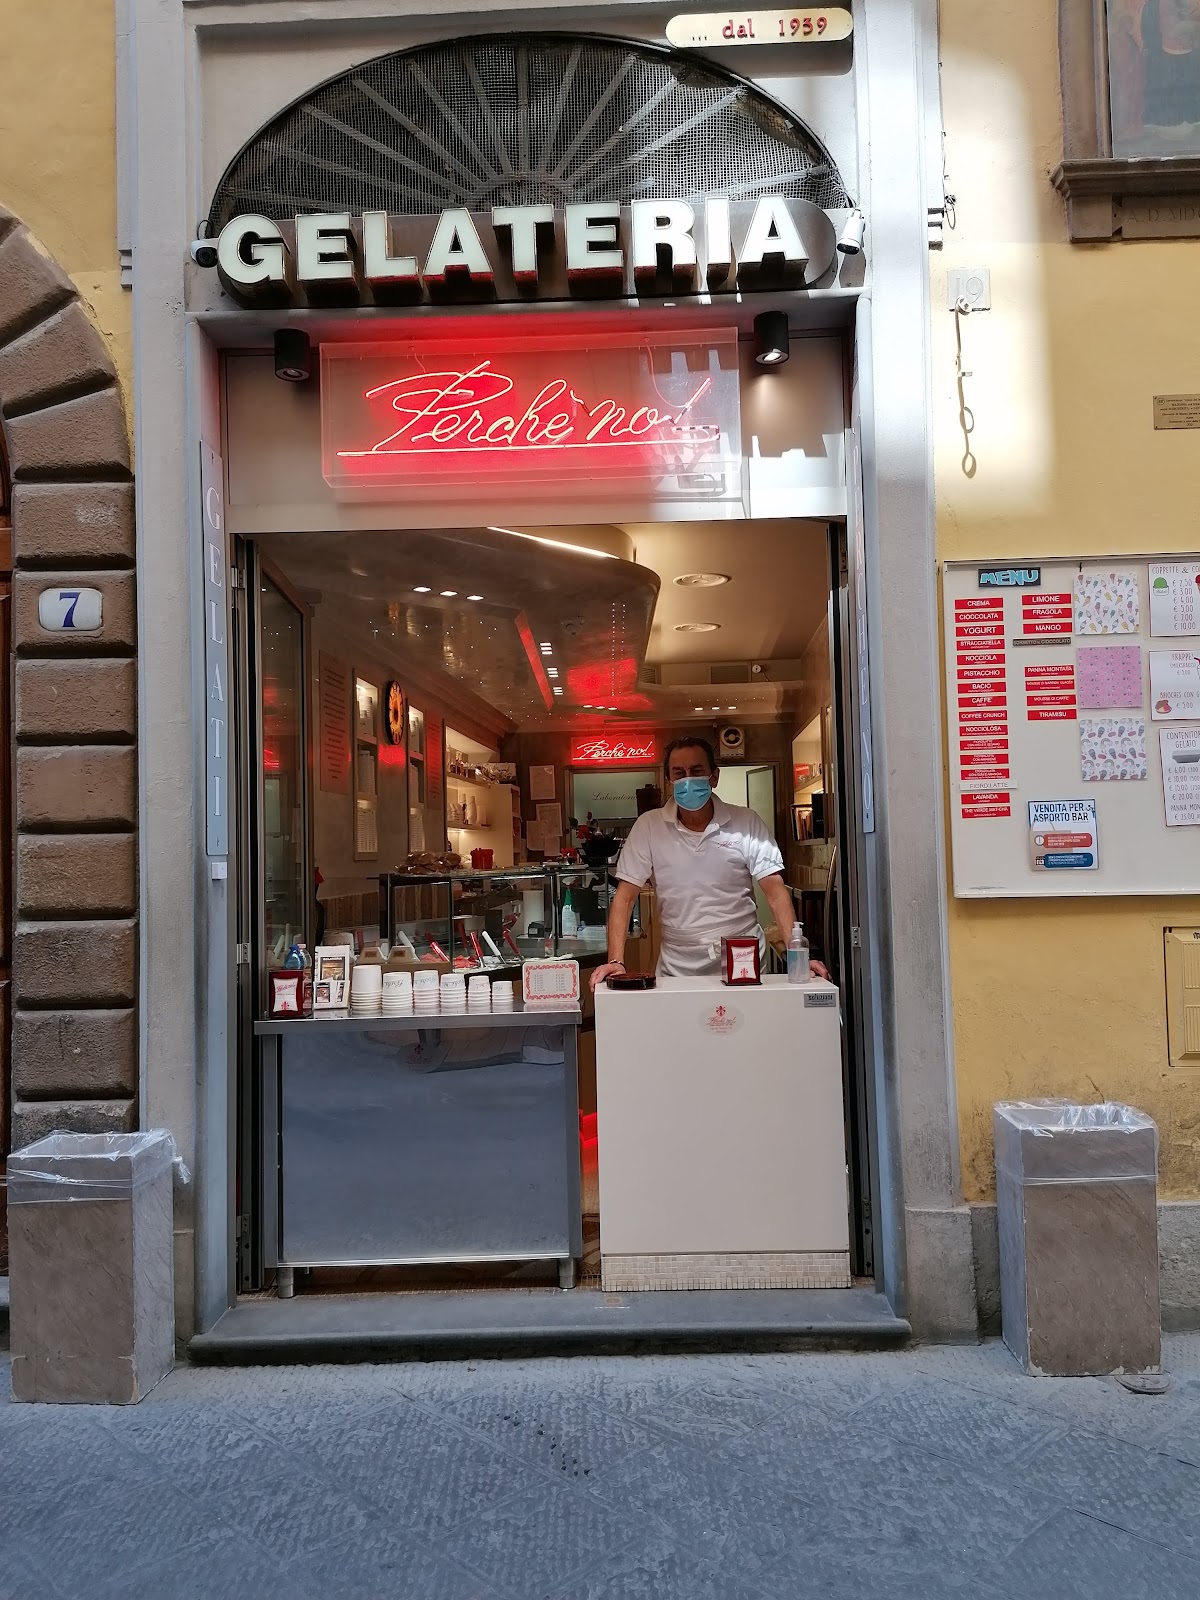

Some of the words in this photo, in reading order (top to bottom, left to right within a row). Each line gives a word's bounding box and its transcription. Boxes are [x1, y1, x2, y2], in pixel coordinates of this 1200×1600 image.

[722, 18, 755, 39] dal
[778, 16, 828, 37] 1939
[216, 194, 809, 284] GELATERIA
[980, 570, 1039, 586] MENU
[1032, 595, 1060, 603] LIMONE
[58, 592, 82, 628] 7
[963, 626, 997, 635] YOGURT
[205, 486, 225, 818] GELATI
[982, 711, 1006, 719] CRUNCH
[1175, 740, 1197, 749] GELATO
[1033, 803, 1067, 813] VENDITA
[1069, 802, 1084, 812] PER
[1033, 813, 1070, 822] ASPORTO
[1072, 812, 1089, 821] BAR
